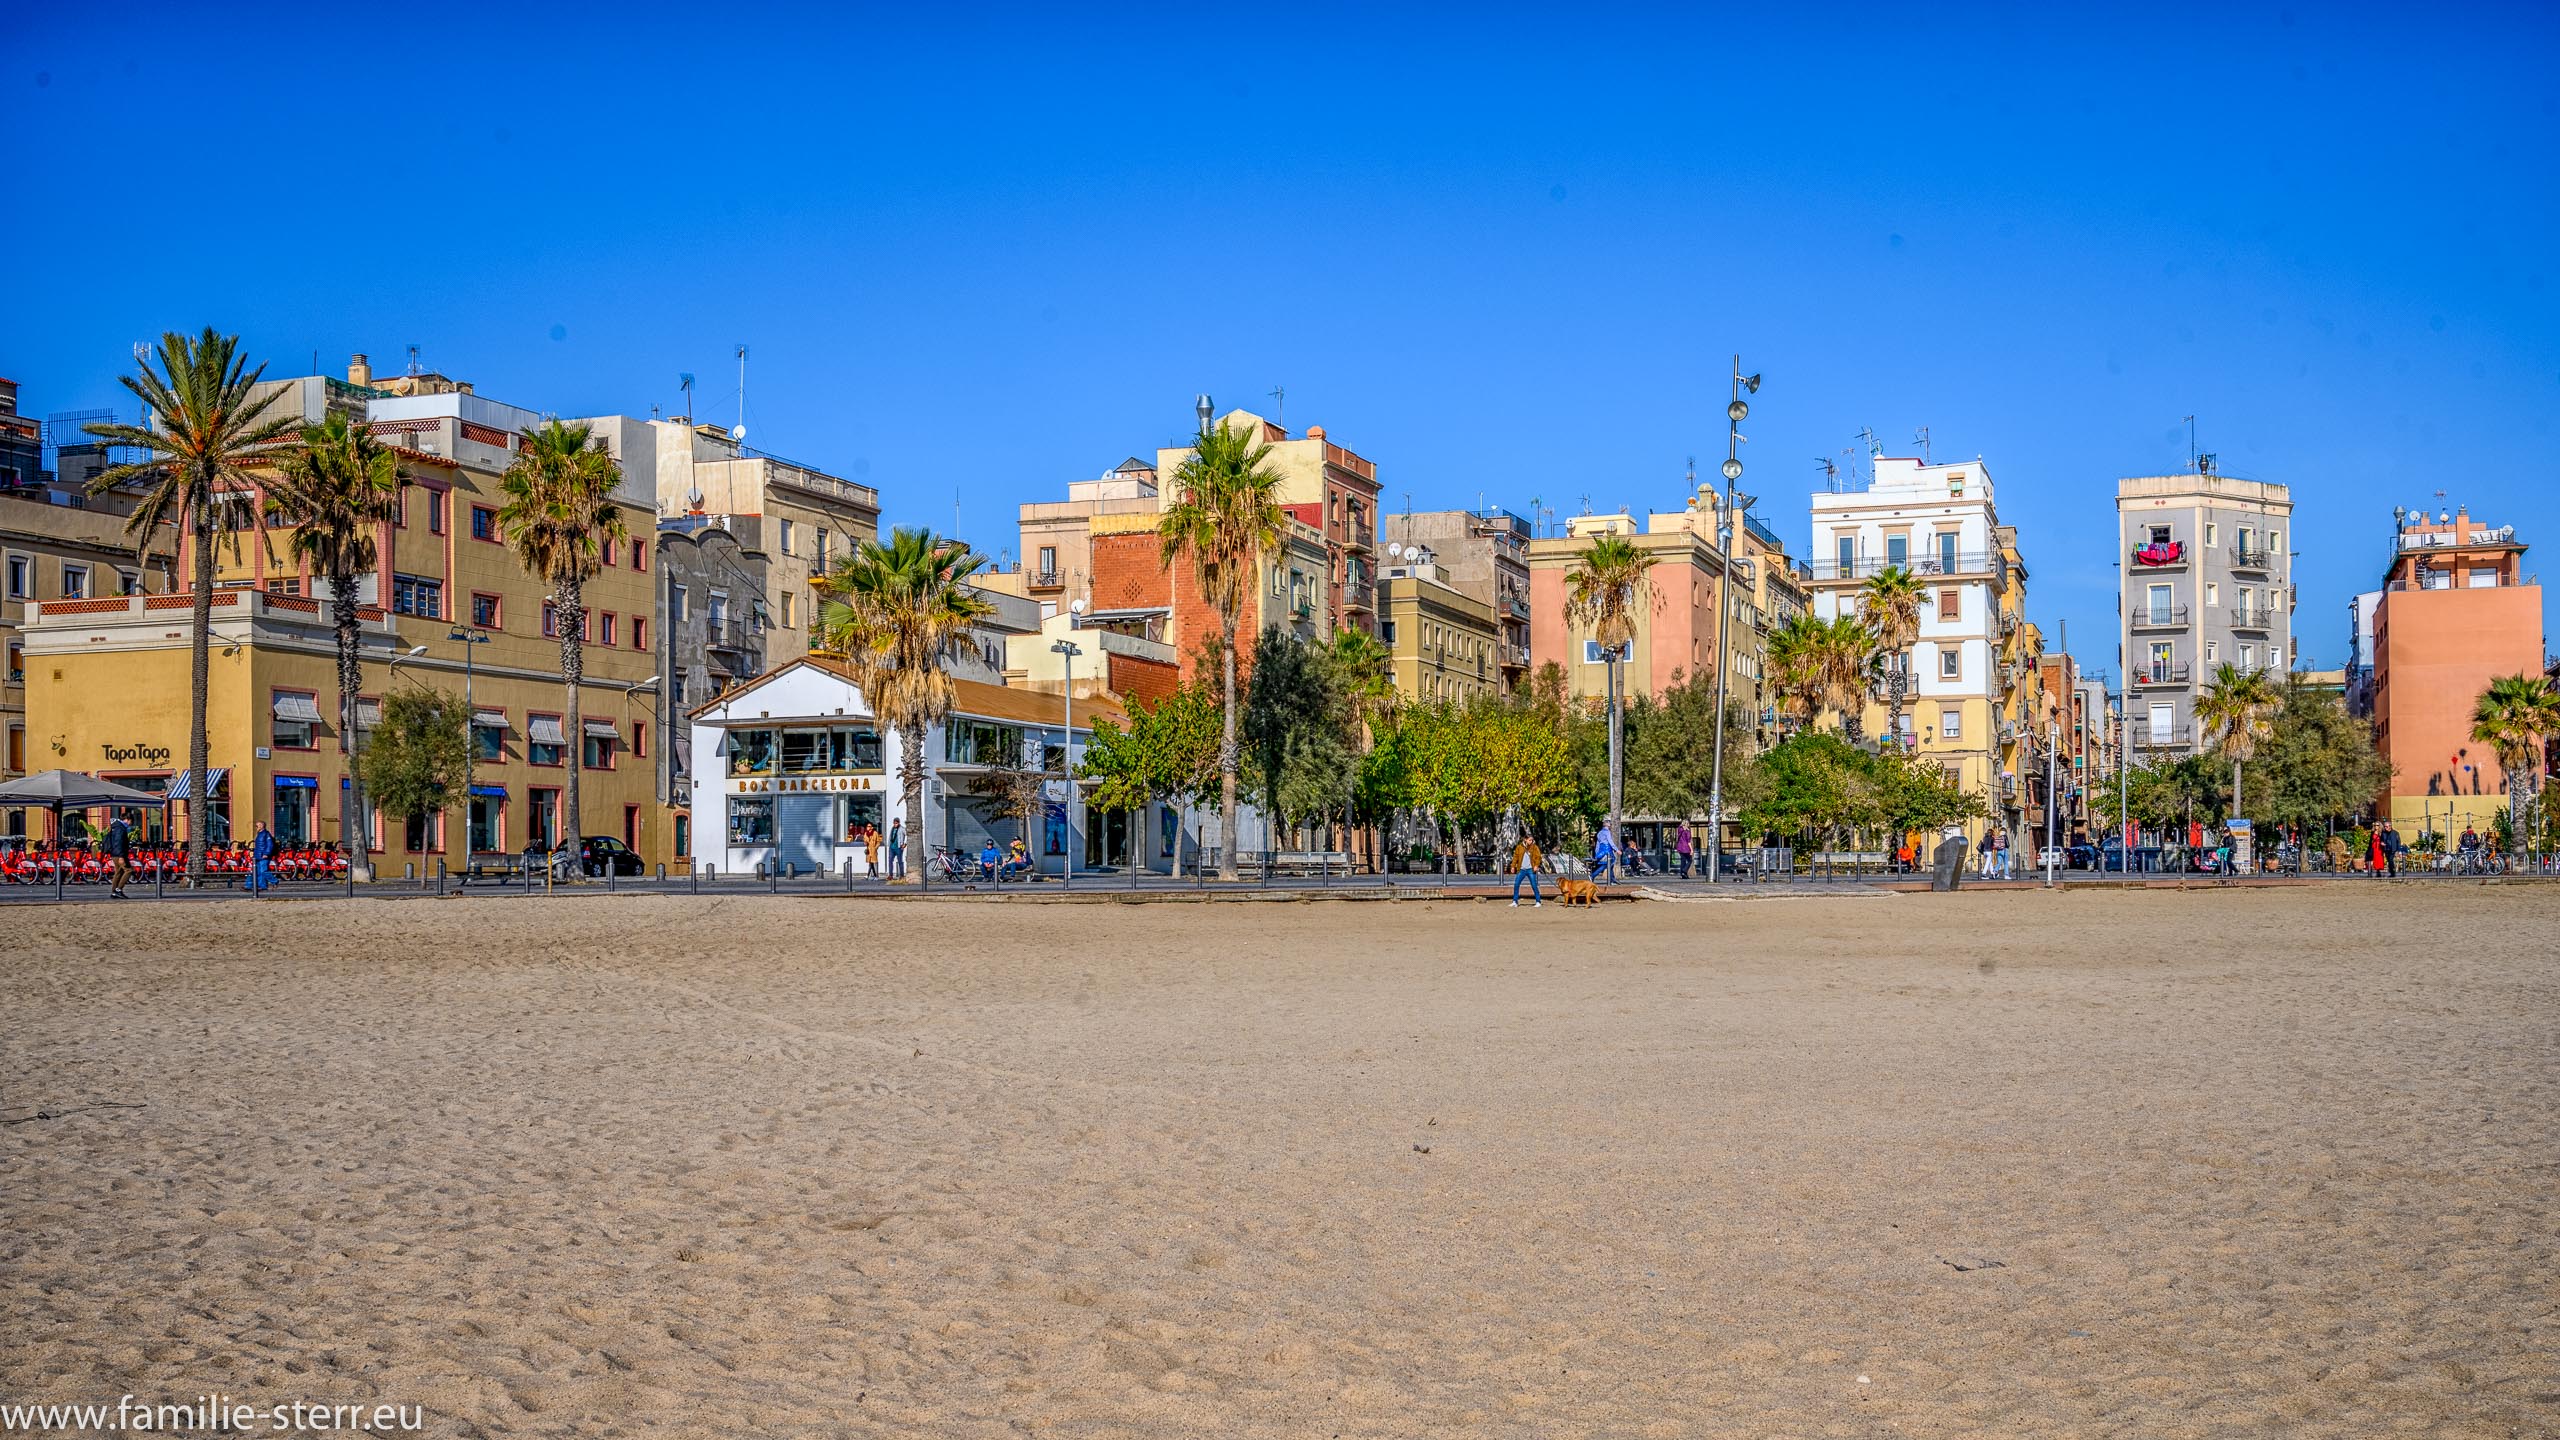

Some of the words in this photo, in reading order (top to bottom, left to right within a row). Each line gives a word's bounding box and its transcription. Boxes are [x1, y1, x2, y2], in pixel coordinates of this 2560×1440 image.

[102, 744, 136, 764] Tapa
[135, 743, 170, 763] Tapa
[739, 780, 769, 792] BOX
[779, 778, 870, 791] BARCELONA
